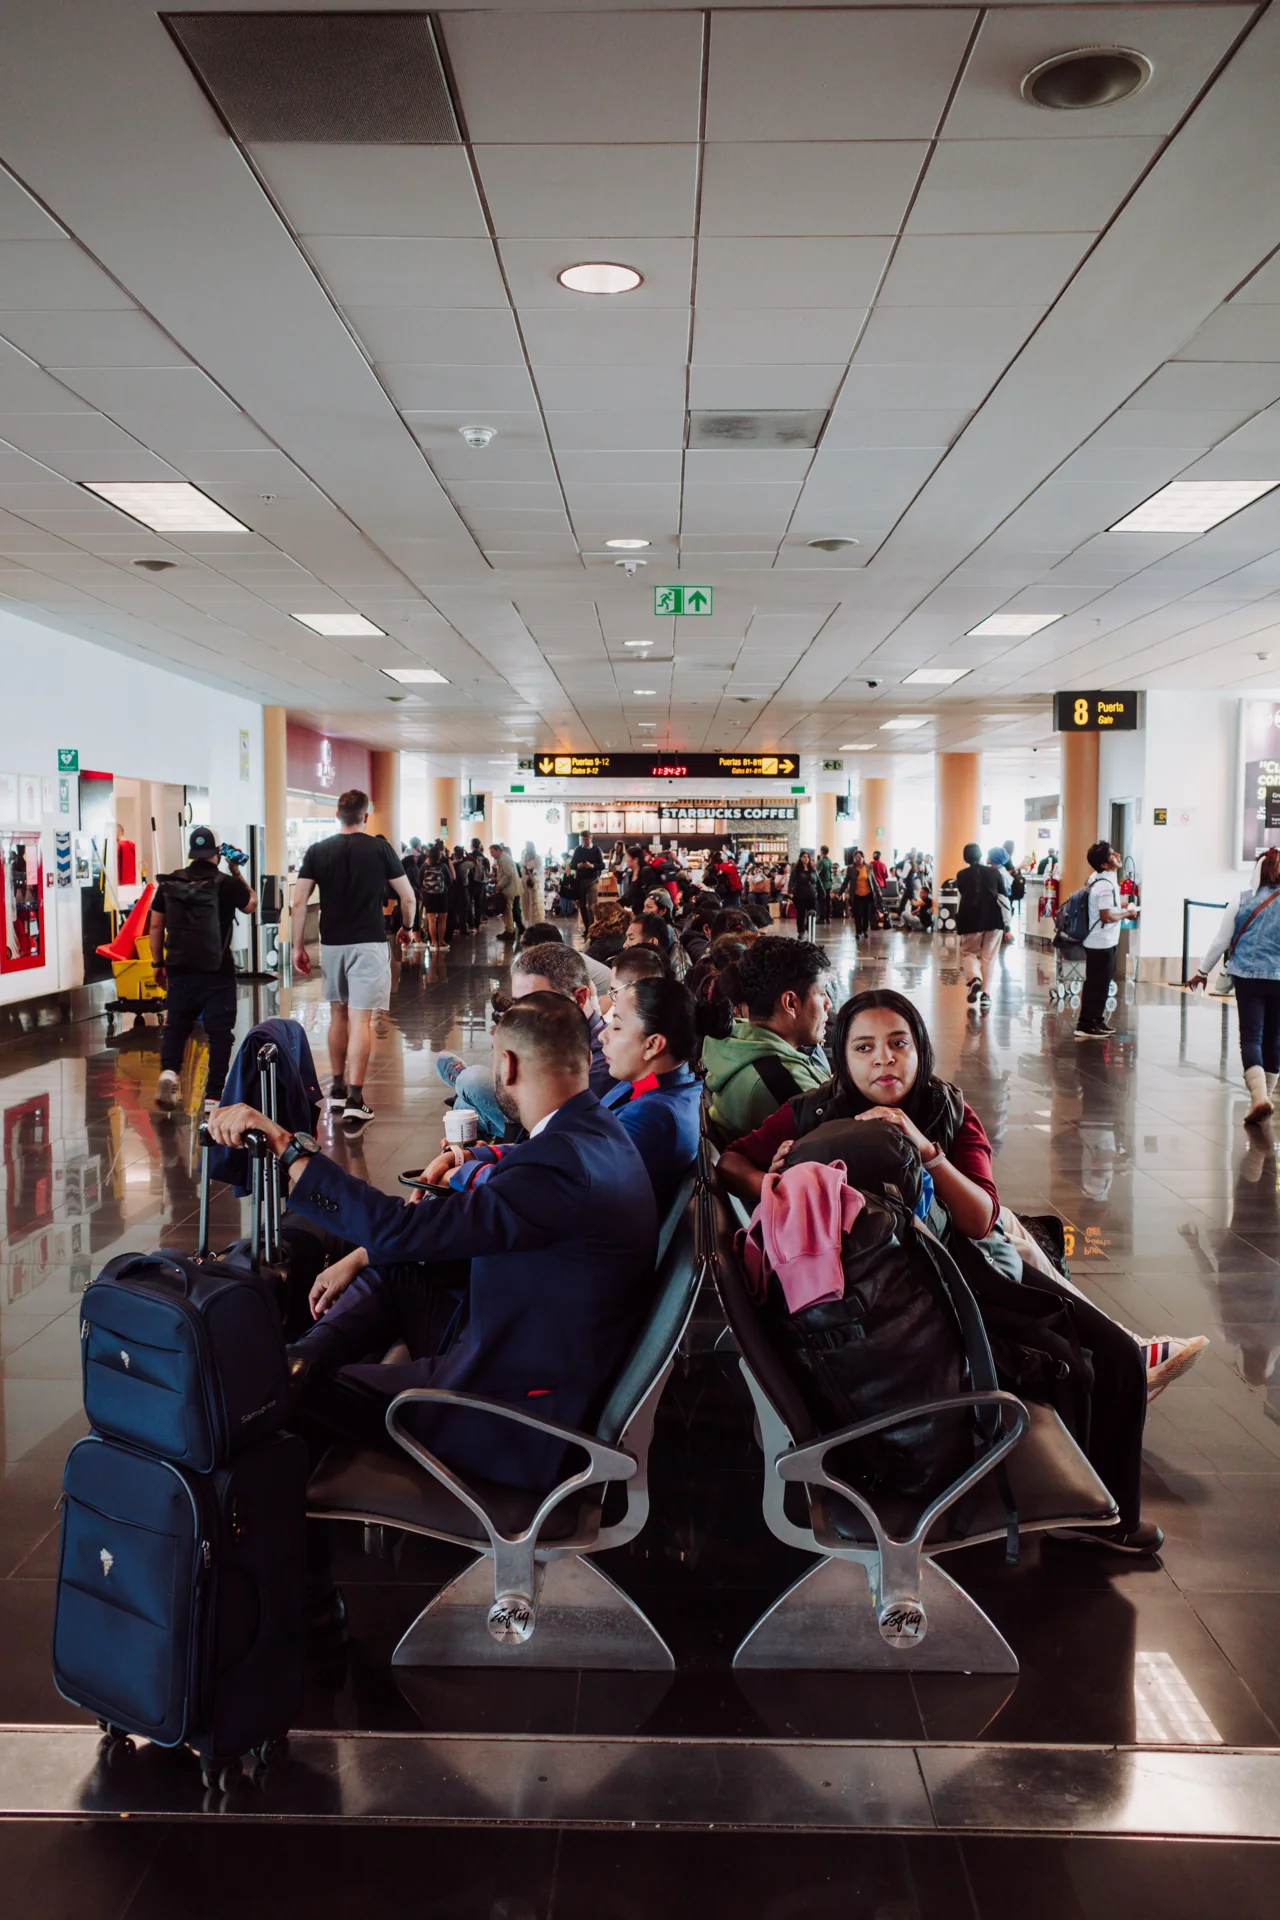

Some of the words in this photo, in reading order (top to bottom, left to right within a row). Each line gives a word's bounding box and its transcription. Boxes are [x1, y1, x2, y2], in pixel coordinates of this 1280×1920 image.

[1098, 701, 1124, 712] Puerta
[1074, 698, 1088, 725] 8
[1098, 715, 1114, 724] Gate
[572, 757, 594, 766] Puertas
[594, 757, 610, 766] 9-12
[719, 757, 741, 766] Puertas
[652, 767, 687, 775] 11:34:27
[661, 808, 742, 819] STARBUCKS
[743, 808, 795, 819] COFFEE
